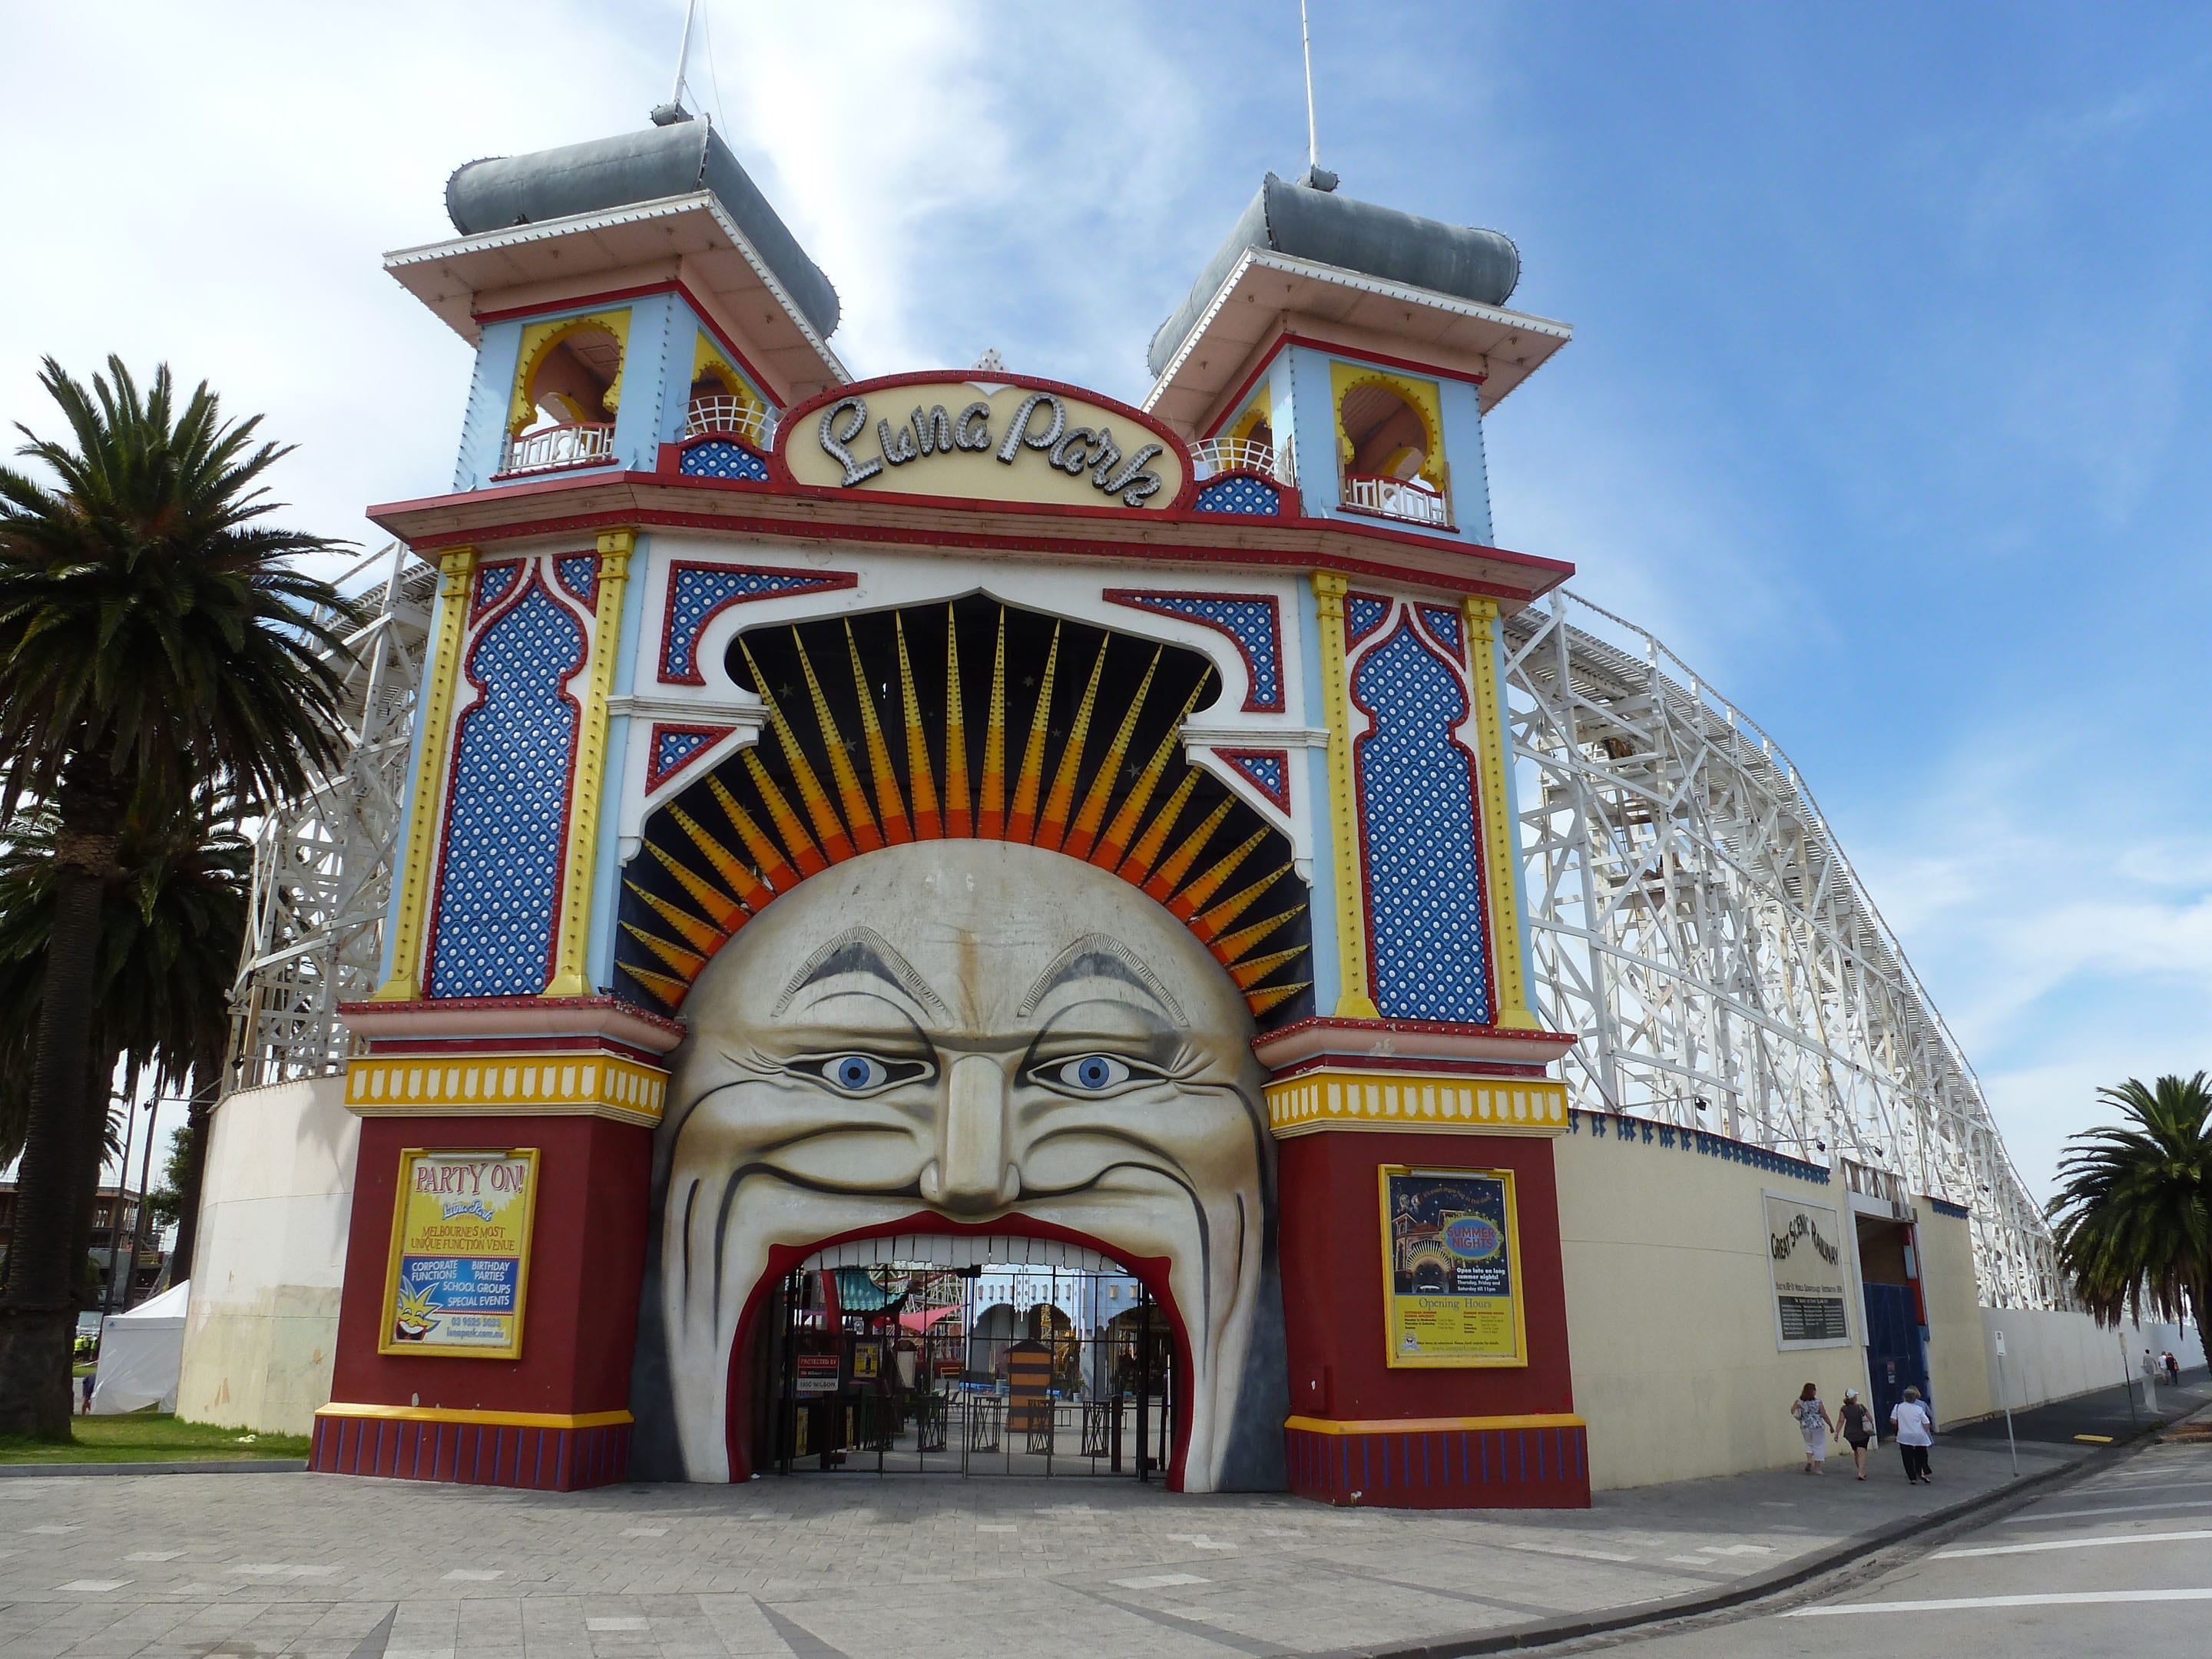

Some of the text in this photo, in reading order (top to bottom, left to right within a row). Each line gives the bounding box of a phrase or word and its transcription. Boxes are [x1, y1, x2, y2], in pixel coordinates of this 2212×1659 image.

[818, 392, 1164, 508] Luna Park
[416, 1163, 525, 1196] PARTY ON!
[442, 1199, 495, 1222] Luna Park
[481, 1227, 505, 1238] MOST
[1447, 1227, 1495, 1238] SUMMER
[411, 1237, 515, 1250] UNIQUE FUNCTION VENUE
[1452, 1238, 1493, 1248] NIGHTS
[1771, 1214, 1839, 1267] GREAT SCENIC RAILWAY
[412, 1260, 459, 1271] CORPORATE
[472, 1260, 510, 1271] BIRTHDAY
[412, 1270, 457, 1281] FUNCTIONS
[474, 1271, 505, 1281] PARTIES
[1457, 1267, 1472, 1276] Open
[443, 1281, 511, 1294] SCHOOL GROUPS
[448, 1295, 509, 1306] SPECIAL EVENTS
[1419, 1296, 1492, 1310] Opening Hours
